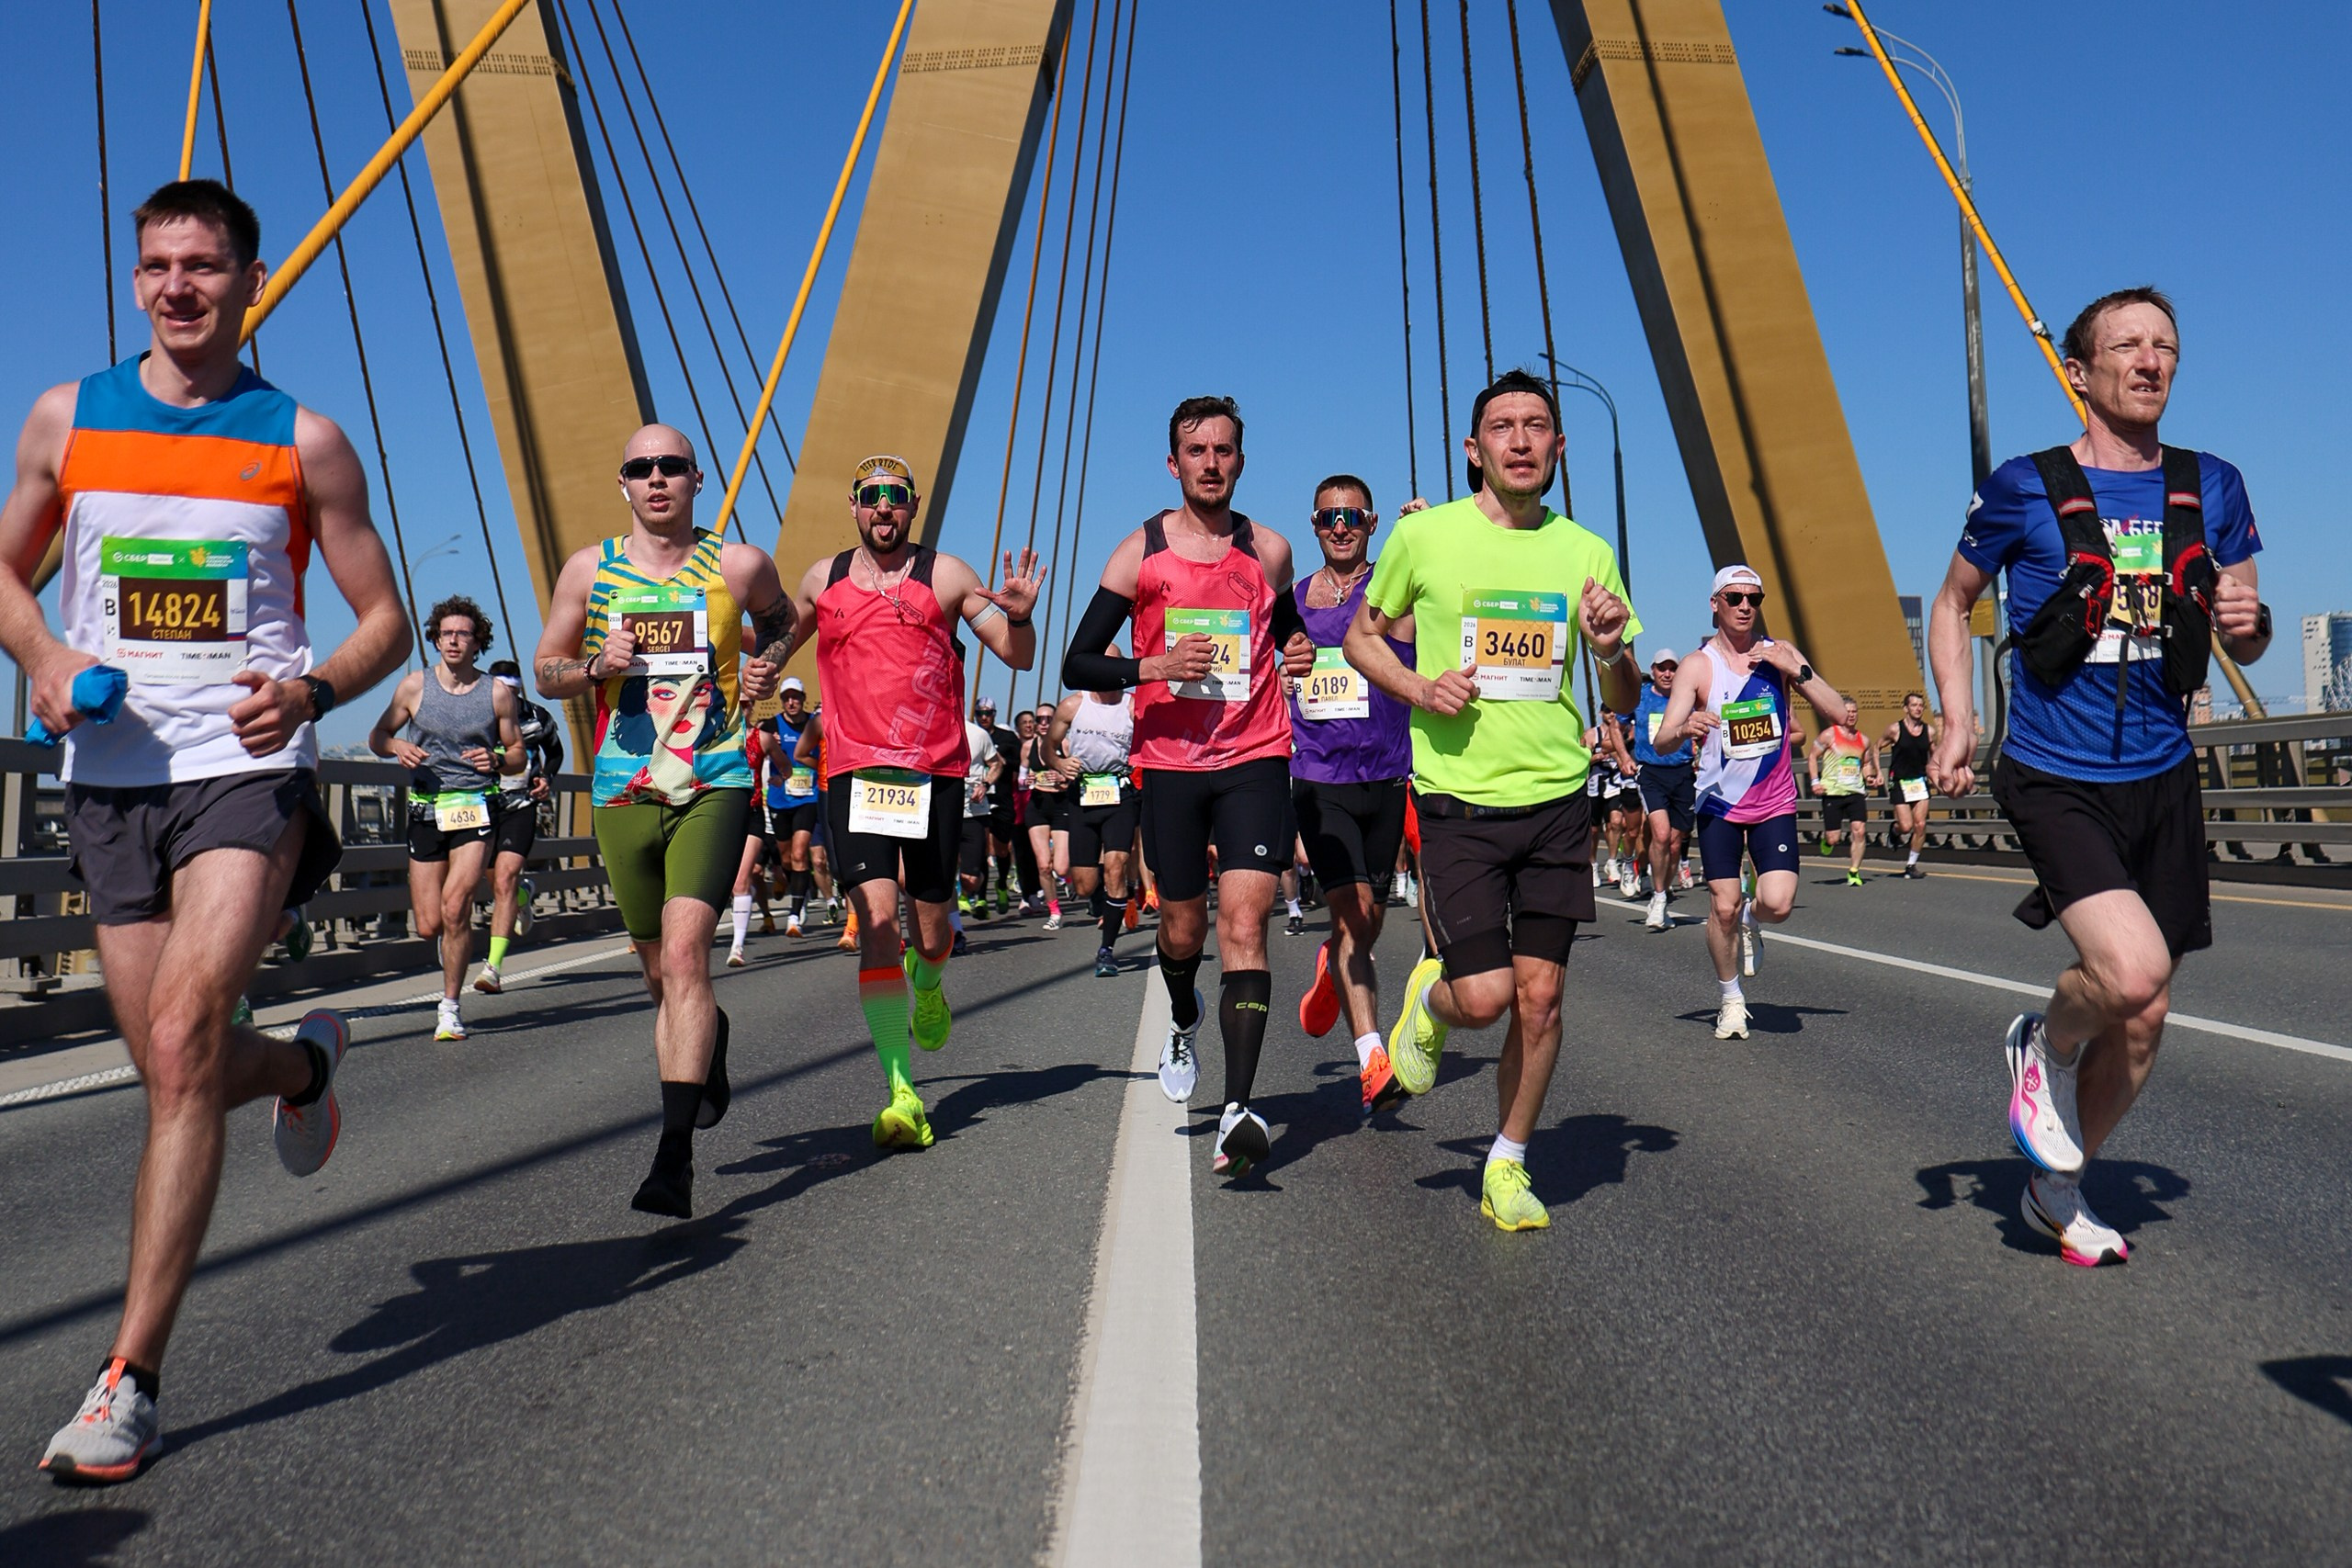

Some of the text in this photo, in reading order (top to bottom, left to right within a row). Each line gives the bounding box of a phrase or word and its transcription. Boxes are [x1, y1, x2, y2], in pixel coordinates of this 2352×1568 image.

[105, 598, 116, 616] B
[129, 591, 221, 628] 14824
[152, 628, 192, 640] СТЕПАН
[635, 620, 683, 645] 9567
[1464, 636, 1473, 648] B
[1485, 631, 1545, 658] 3460
[127, 651, 164, 660] МАГНИТ
[647, 645, 670, 654] SERGEI
[1210, 643, 1230, 665] 24
[1504, 658, 1526, 667] БУЛАТ
[1295, 683, 1302, 693] B
[1312, 676, 1348, 695] 6189
[1723, 730, 1729, 738] B
[1733, 721, 1771, 740] 10254
[867, 788, 916, 806] 21934
[1091, 790, 1110, 801] 1779
[450, 810, 476, 823] 4636
